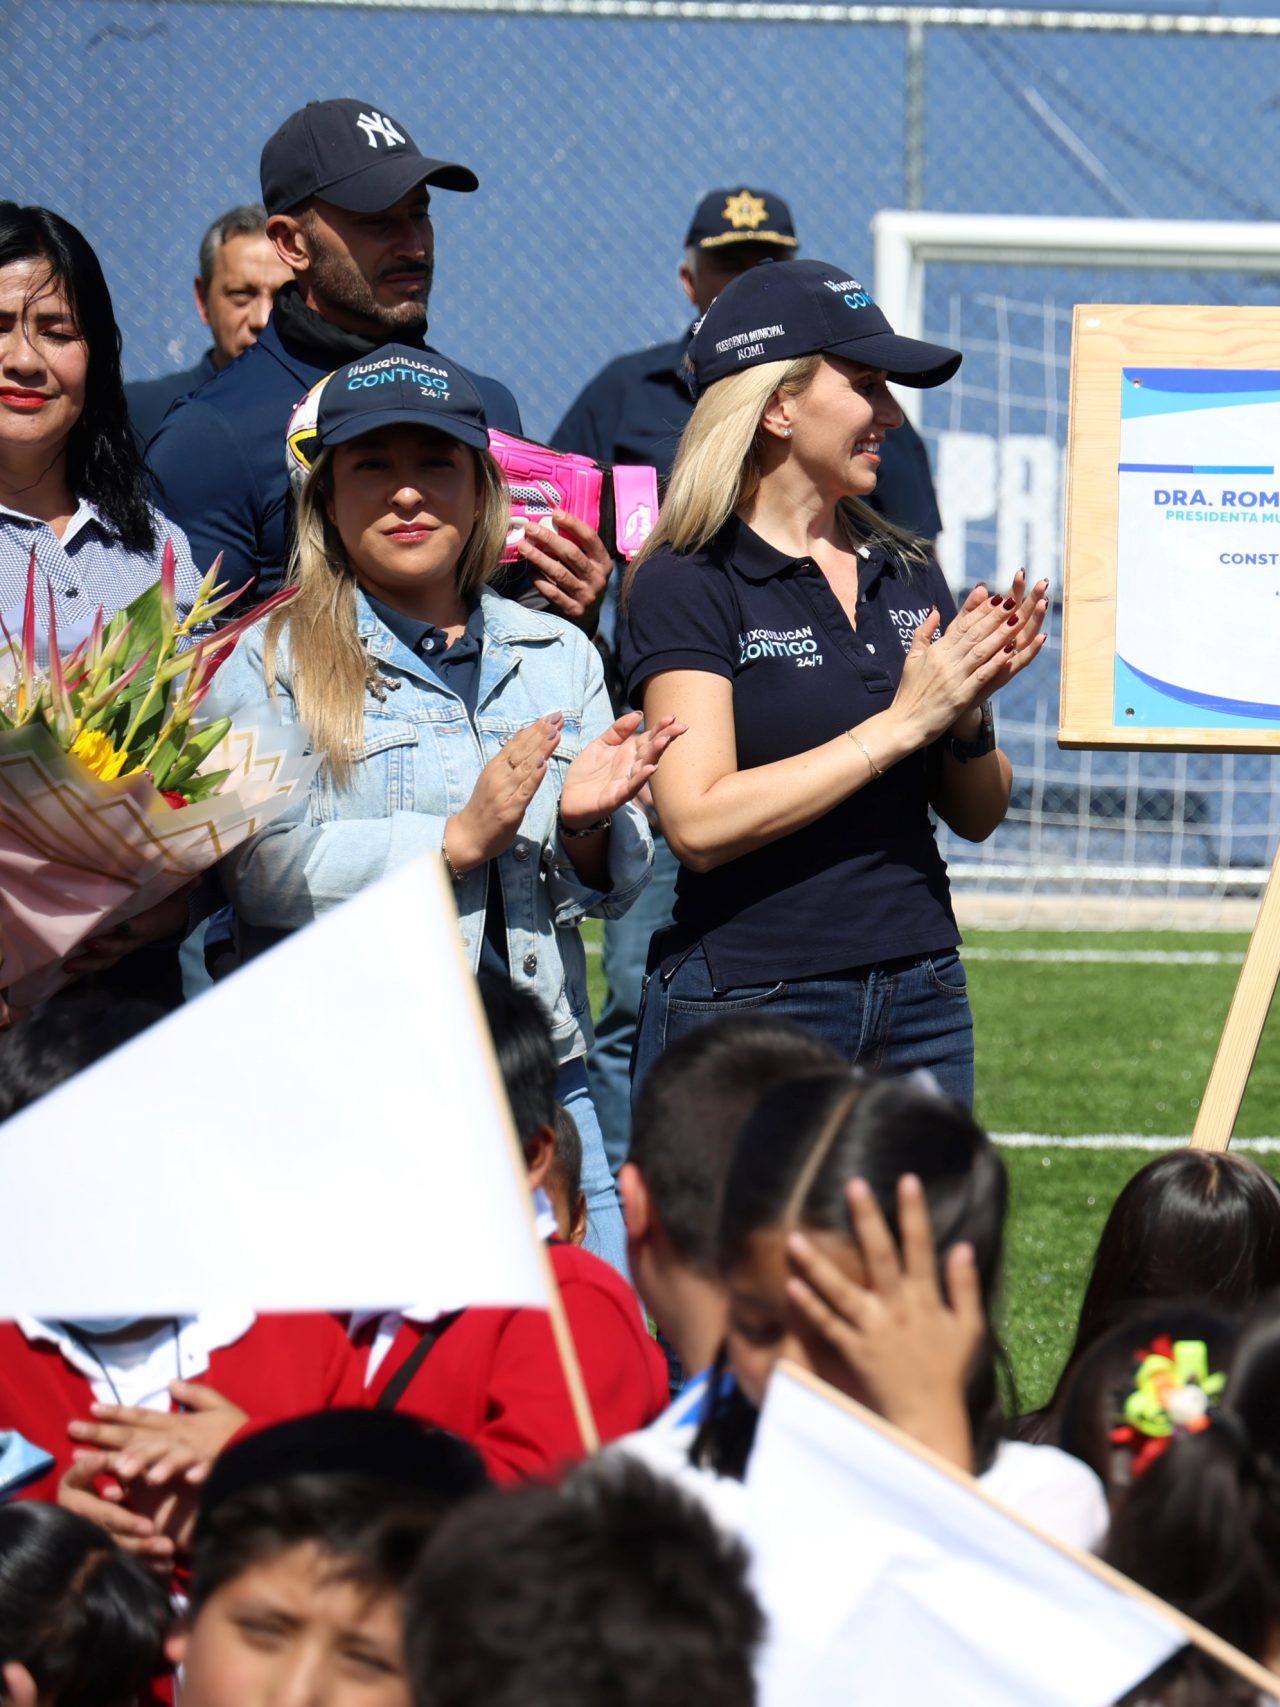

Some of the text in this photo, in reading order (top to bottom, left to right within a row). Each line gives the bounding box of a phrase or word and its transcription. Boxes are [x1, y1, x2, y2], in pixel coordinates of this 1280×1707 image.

[748, 324, 786, 343] MUNICIPAL
[737, 343, 766, 360] ROMI
[347, 356, 449, 379] HUIXQUILUCAN
[347, 367, 449, 391] CONTIGO
[419, 386, 451, 401] 24/7
[1153, 489, 1213, 507] DRA.
[1165, 510, 1259, 523] PRESIDENTA
[796, 654, 823, 667] 24/7
